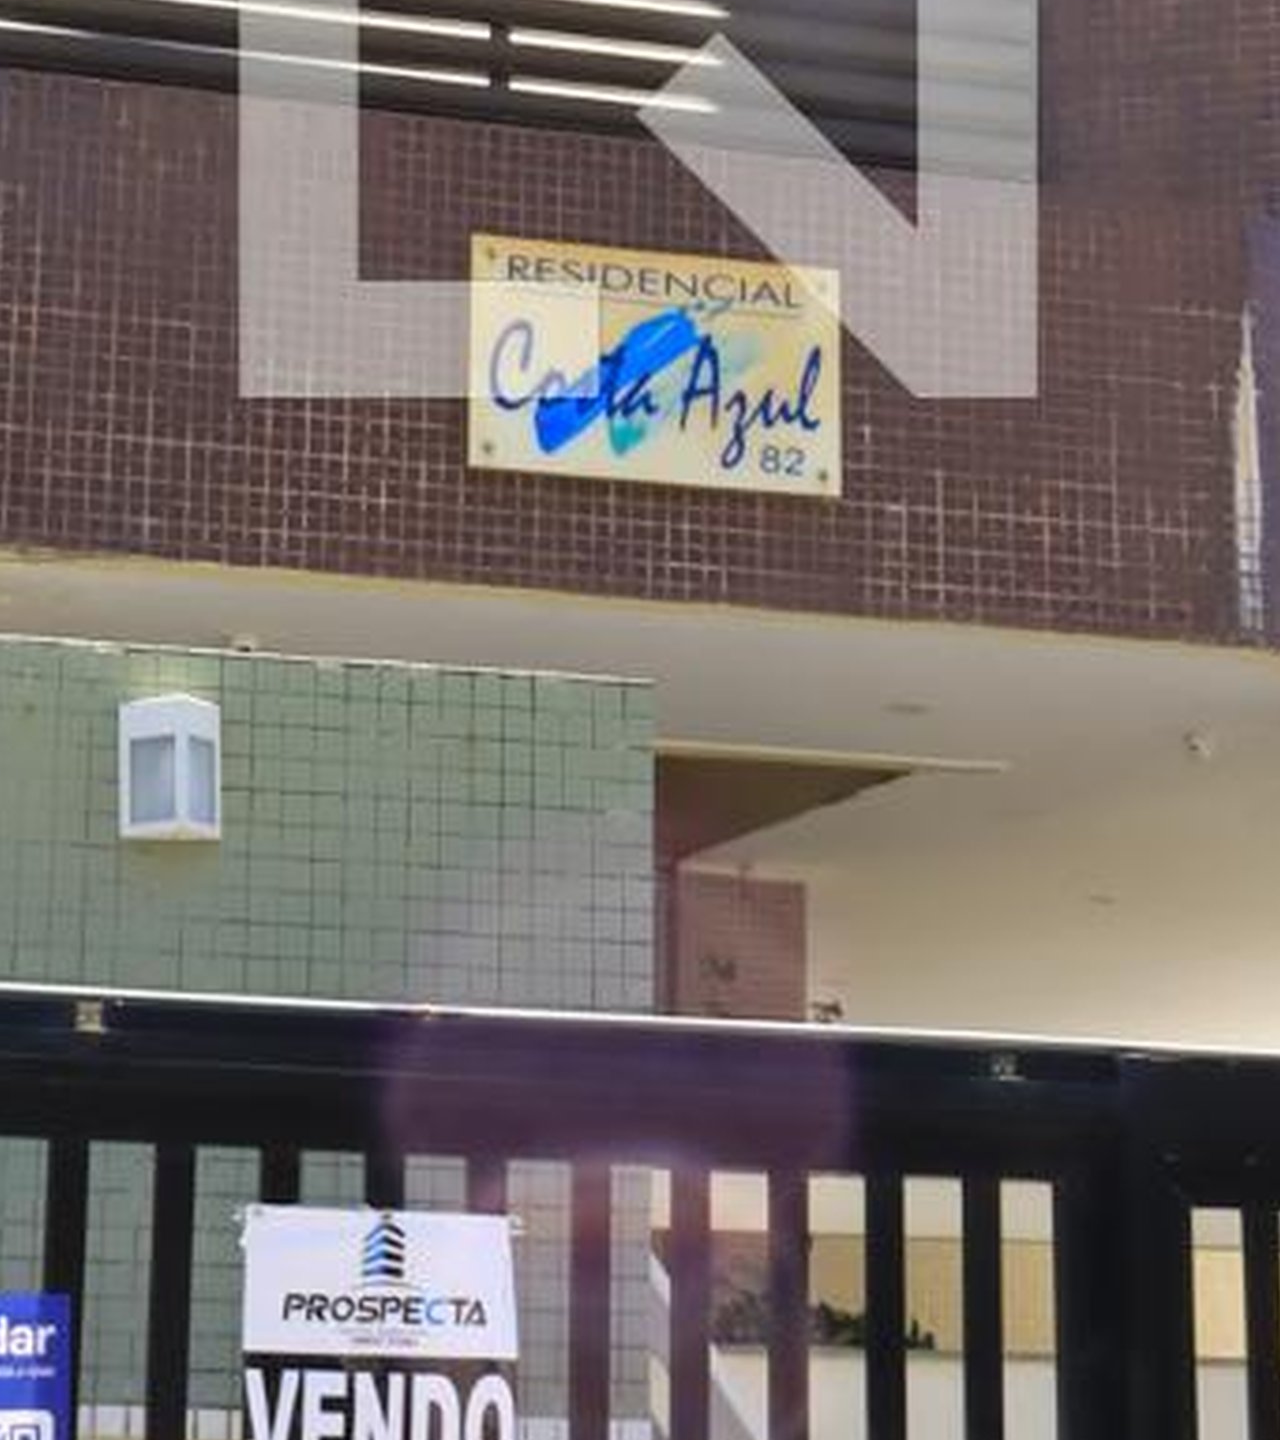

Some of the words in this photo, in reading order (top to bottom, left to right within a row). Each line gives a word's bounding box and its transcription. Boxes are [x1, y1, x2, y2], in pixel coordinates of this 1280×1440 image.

[506, 254, 804, 308] RESIDENCIAL
[679, 334, 821, 470] Azul
[760, 446, 806, 477] 82
[282, 1293, 487, 1326] PROSPECTA
